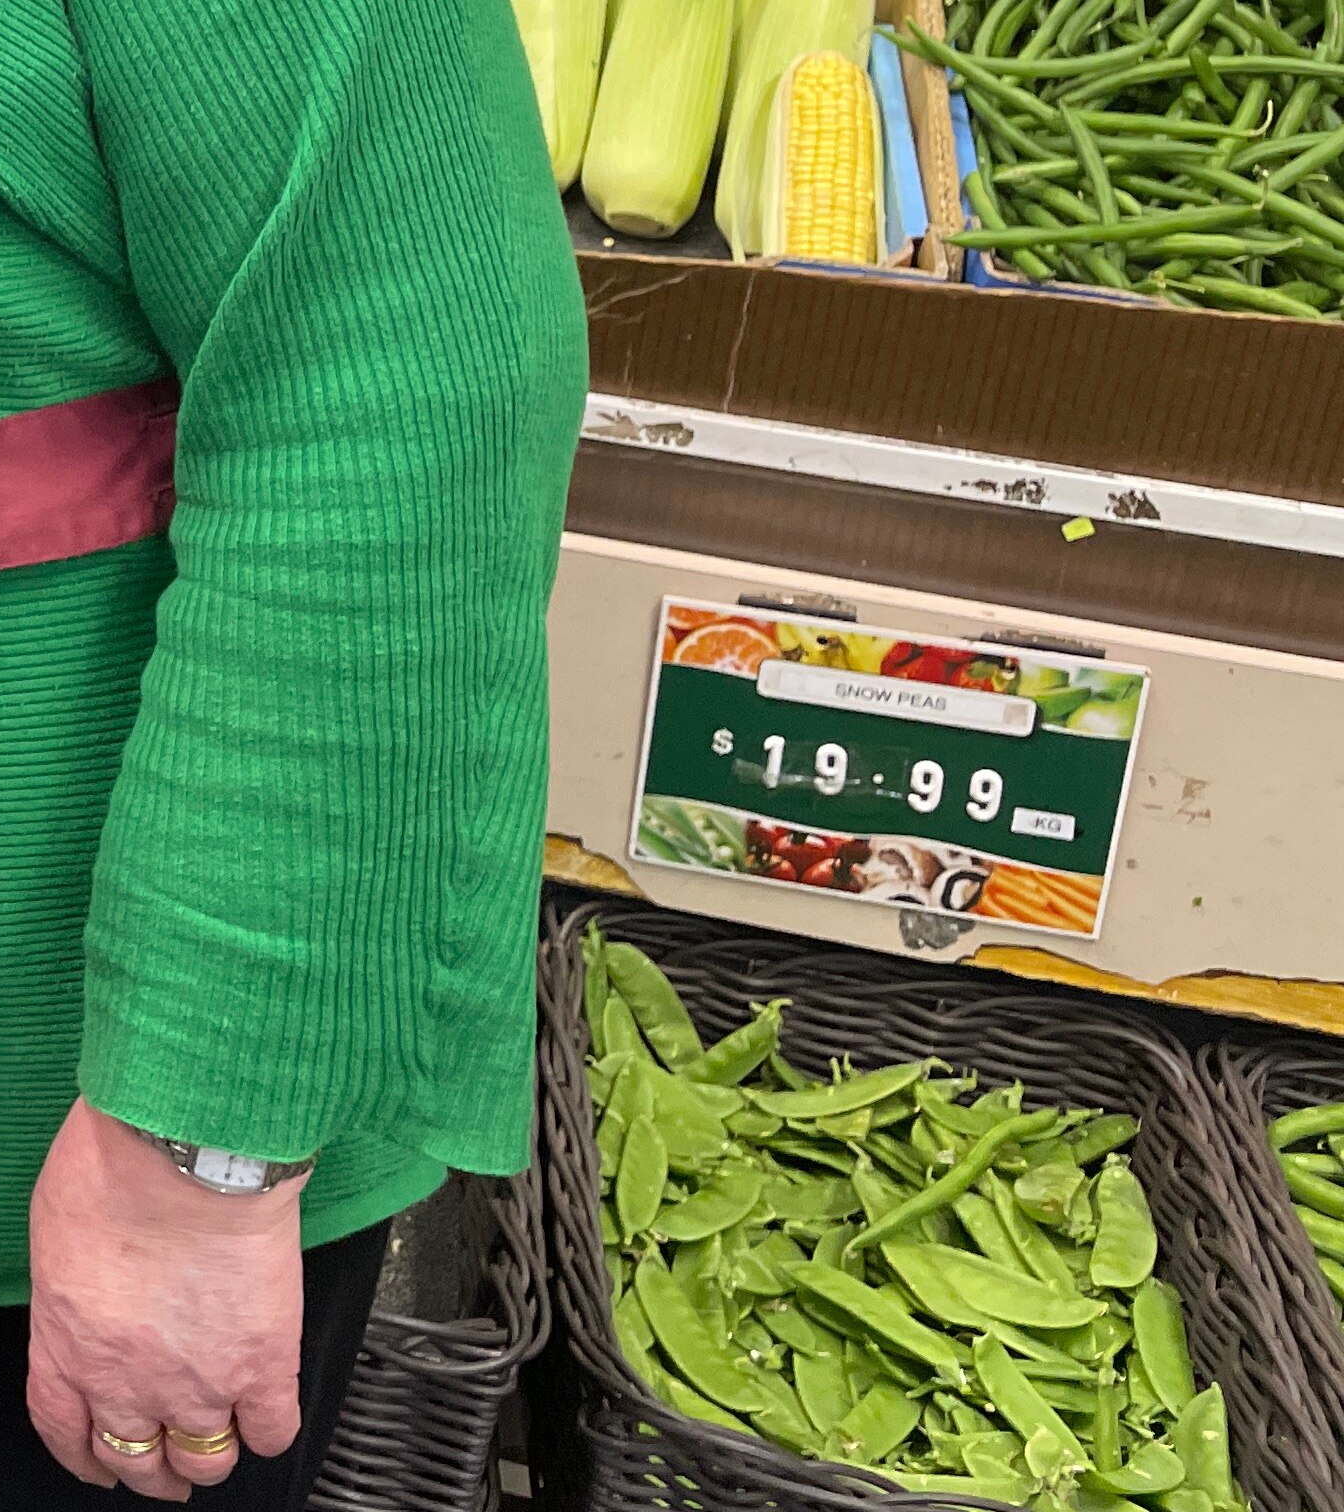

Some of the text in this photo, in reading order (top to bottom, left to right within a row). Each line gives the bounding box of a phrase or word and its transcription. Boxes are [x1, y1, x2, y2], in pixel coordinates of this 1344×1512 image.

[835, 682, 948, 712] SNOW PEAS
[763, 735, 1004, 823] 19.99
[1034, 816, 1062, 833] KG
